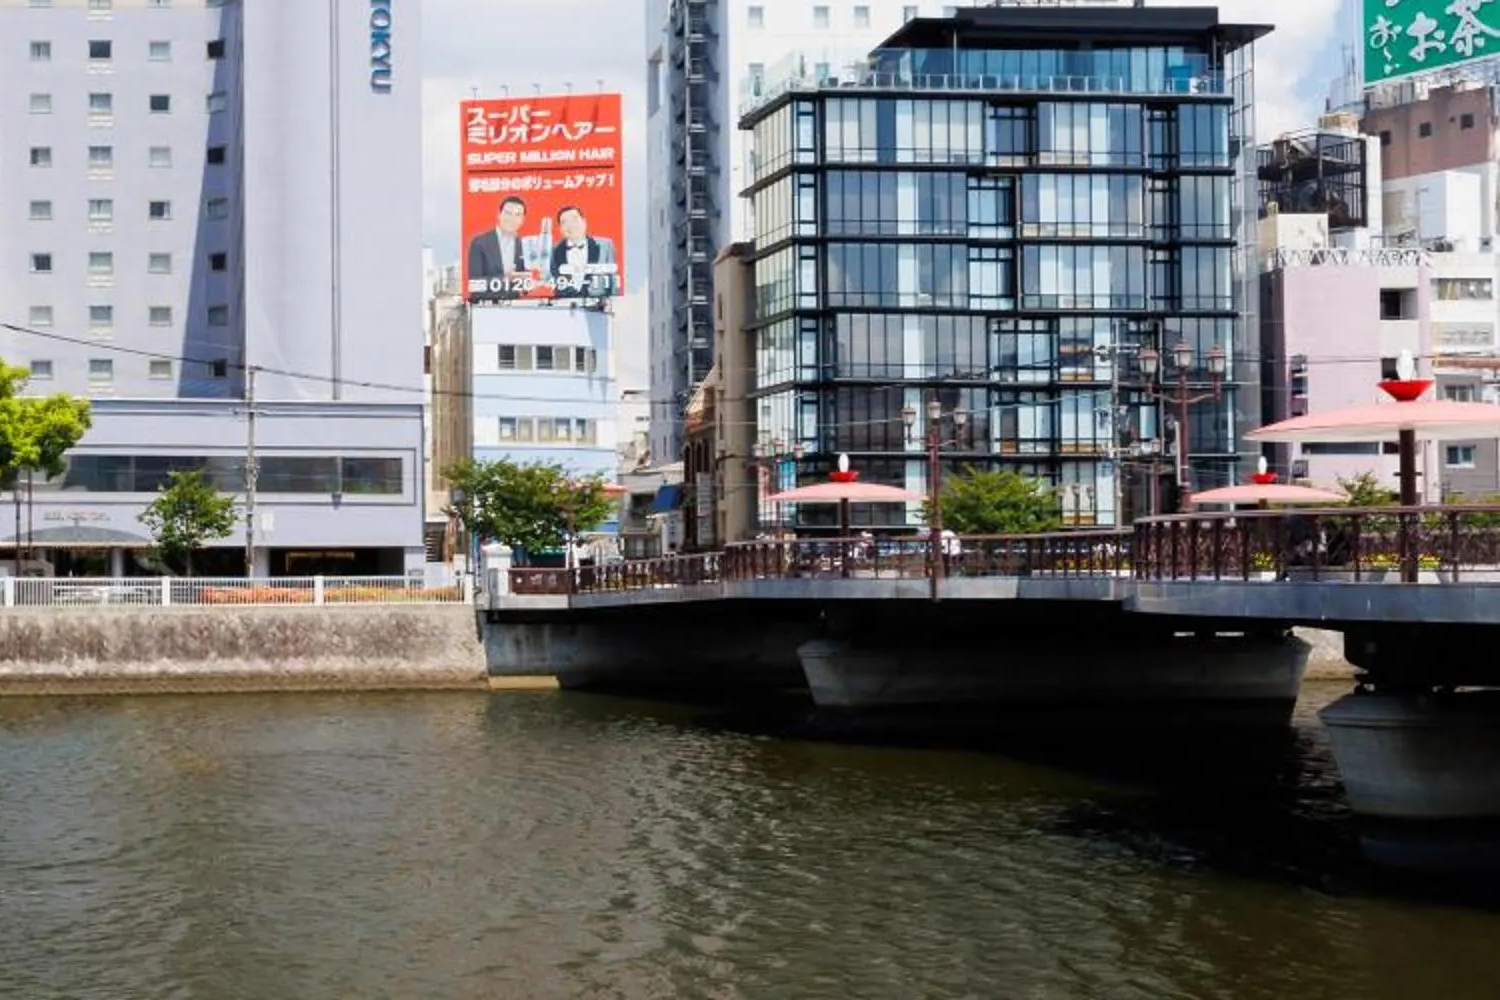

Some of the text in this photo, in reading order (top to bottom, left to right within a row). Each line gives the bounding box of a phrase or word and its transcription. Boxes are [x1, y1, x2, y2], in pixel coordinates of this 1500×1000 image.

[467, 104, 551, 125] スーパー
[467, 121, 616, 145] ミリオンヘアー
[466, 146, 616, 166] SUPER MILLION HAIR
